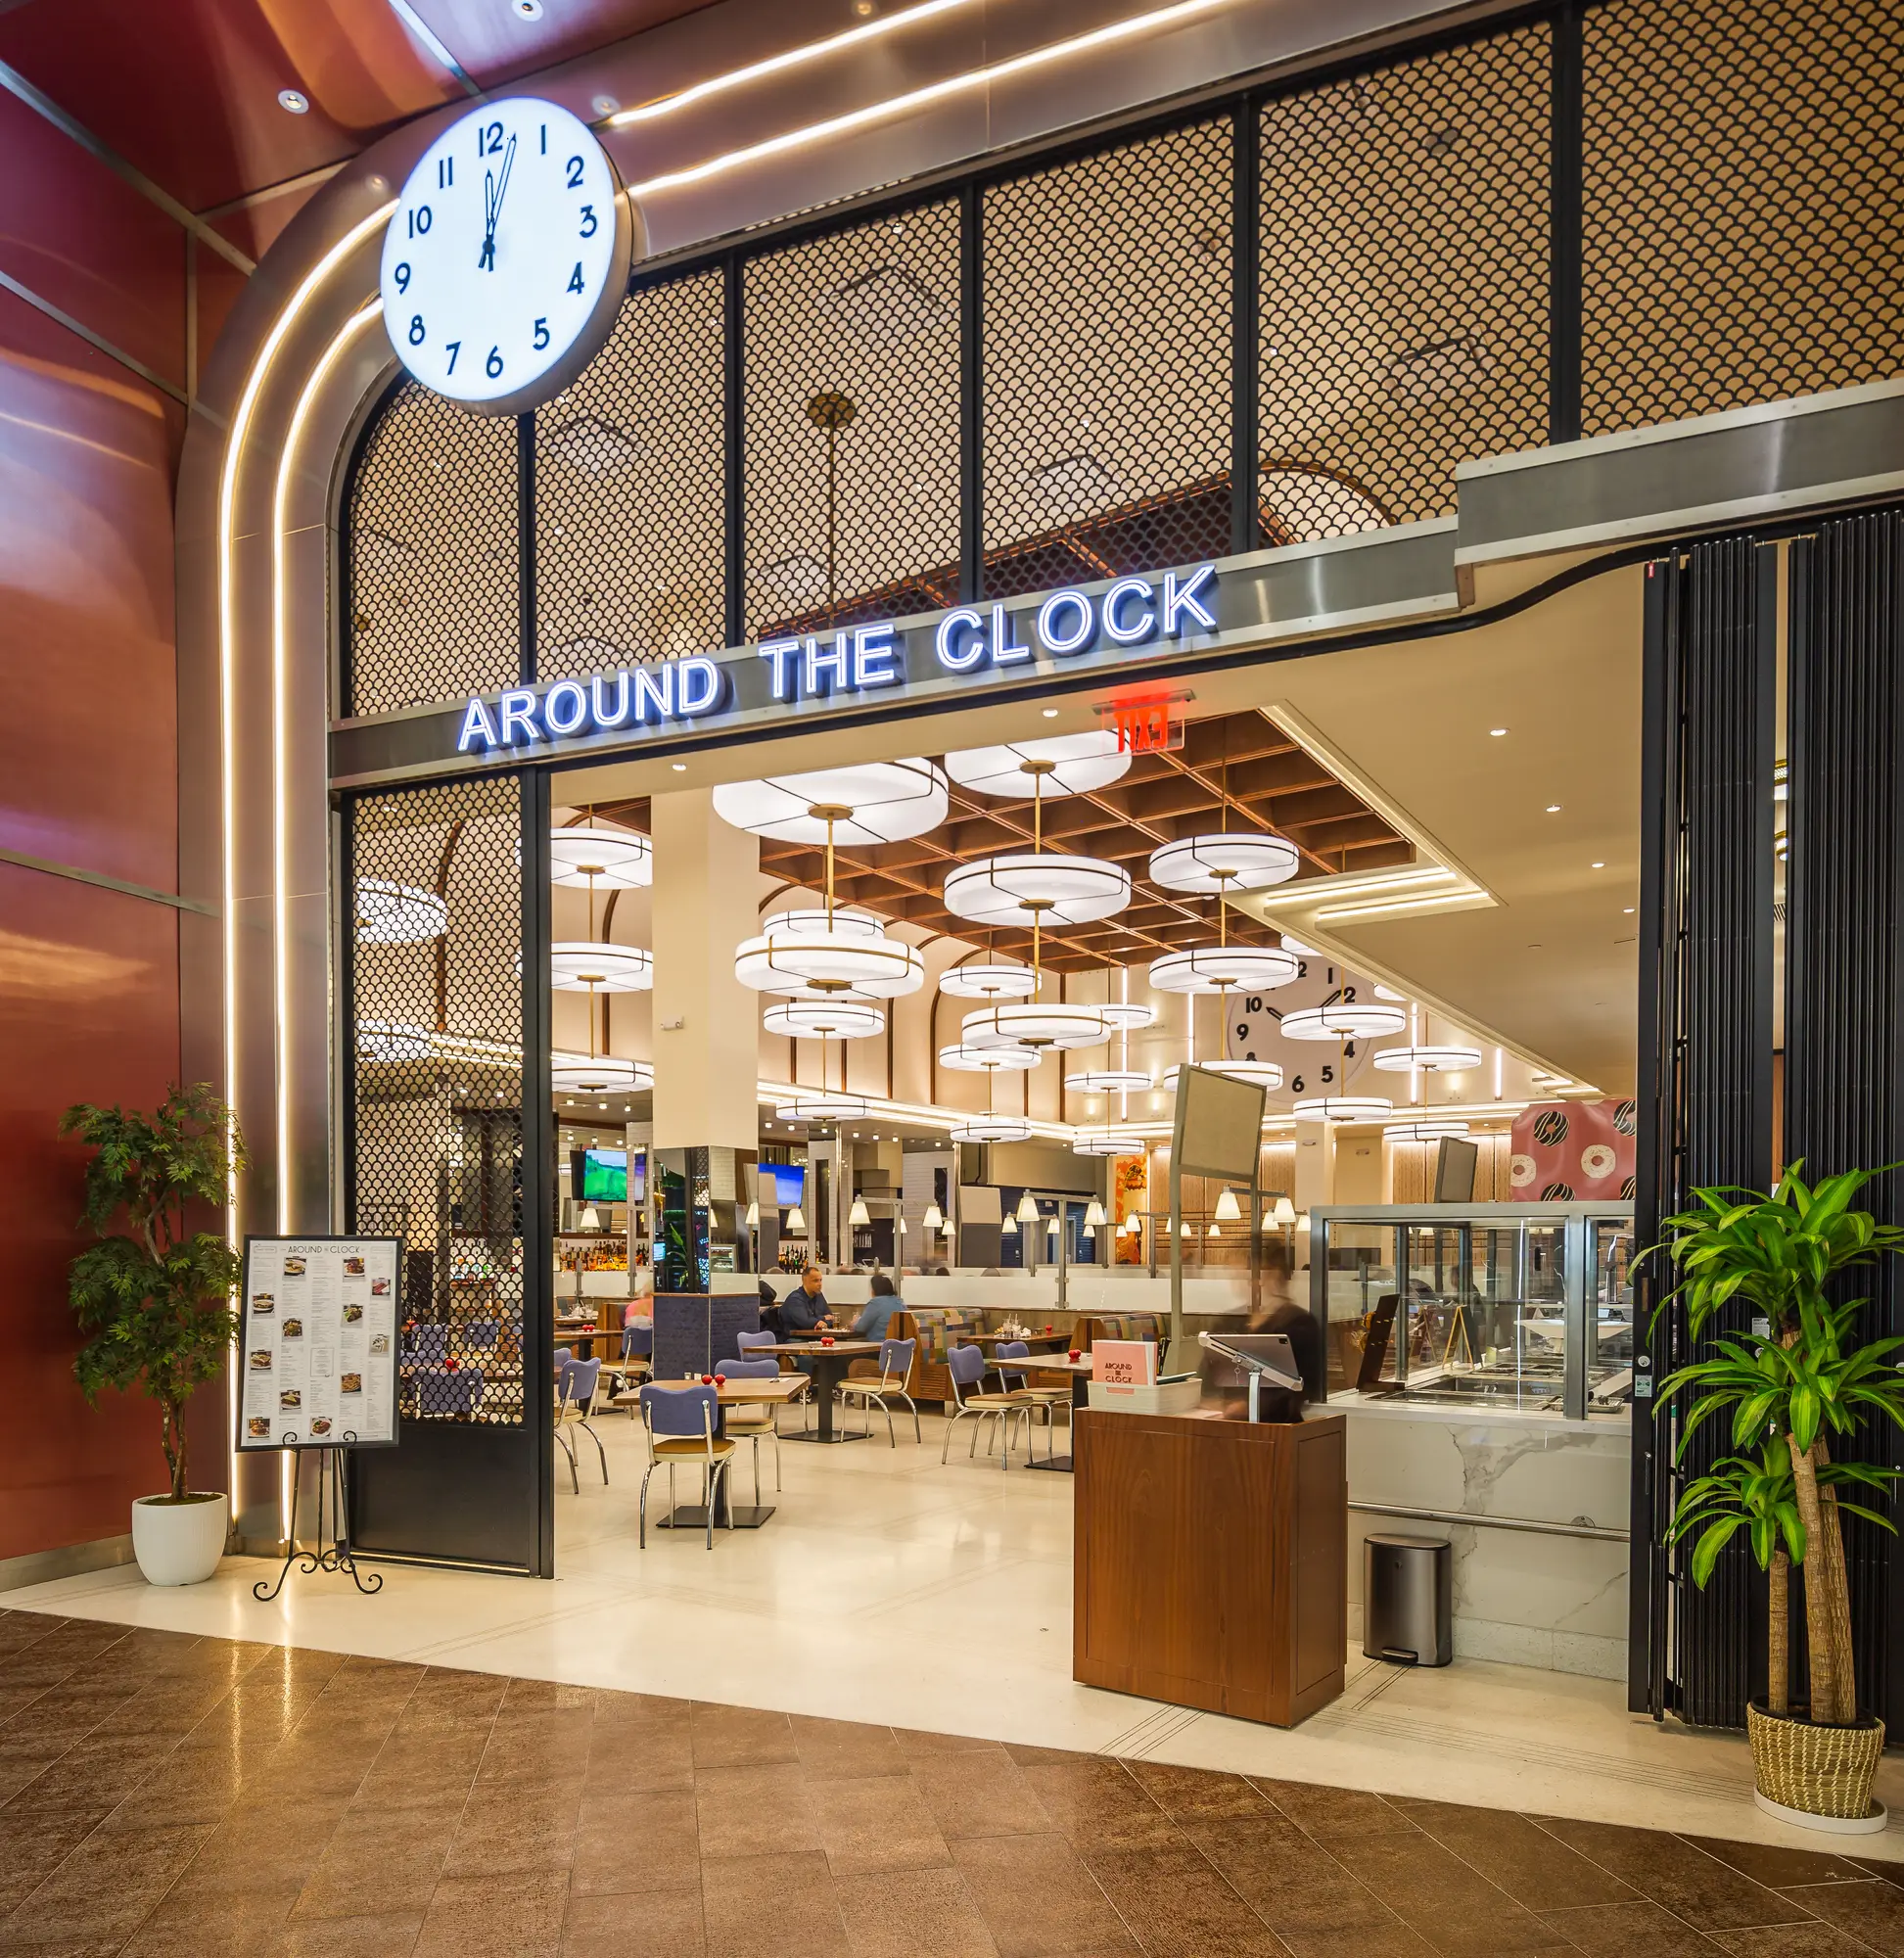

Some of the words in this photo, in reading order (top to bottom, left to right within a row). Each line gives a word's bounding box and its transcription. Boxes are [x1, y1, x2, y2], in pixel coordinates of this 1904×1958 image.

[478, 120, 504, 158] 12
[540, 123, 546, 156] 1
[439, 156, 453, 190] 11
[566, 155, 584, 190] 2
[408, 205, 433, 240] 10
[579, 204, 598, 239] 3
[394, 261, 411, 296] 9
[566, 260, 585, 295] 4
[408, 313, 426, 347] 8
[532, 316, 550, 351] 5
[445, 340, 462, 376] 7
[486, 345, 504, 380] 6
[457, 656, 720, 752] AROUND
[758, 623, 895, 699] THE
[936, 564, 1218, 671] CLOCK
[1327, 966, 1333, 985] 1
[1245, 996, 1263, 1014] 10
[1343, 986, 1357, 1004] 2
[1235, 1023, 1250, 1042] 9
[1343, 1040, 1356, 1058] 4
[1291, 1074, 1305, 1094] 6
[1321, 1065, 1334, 1084] 5
[288, 1245, 323, 1254] AROUND
[330, 1245, 360, 1254] CLOCK
[1104, 1362, 1133, 1371] AROUND
[1105, 1375, 1133, 1384] CLOCK
